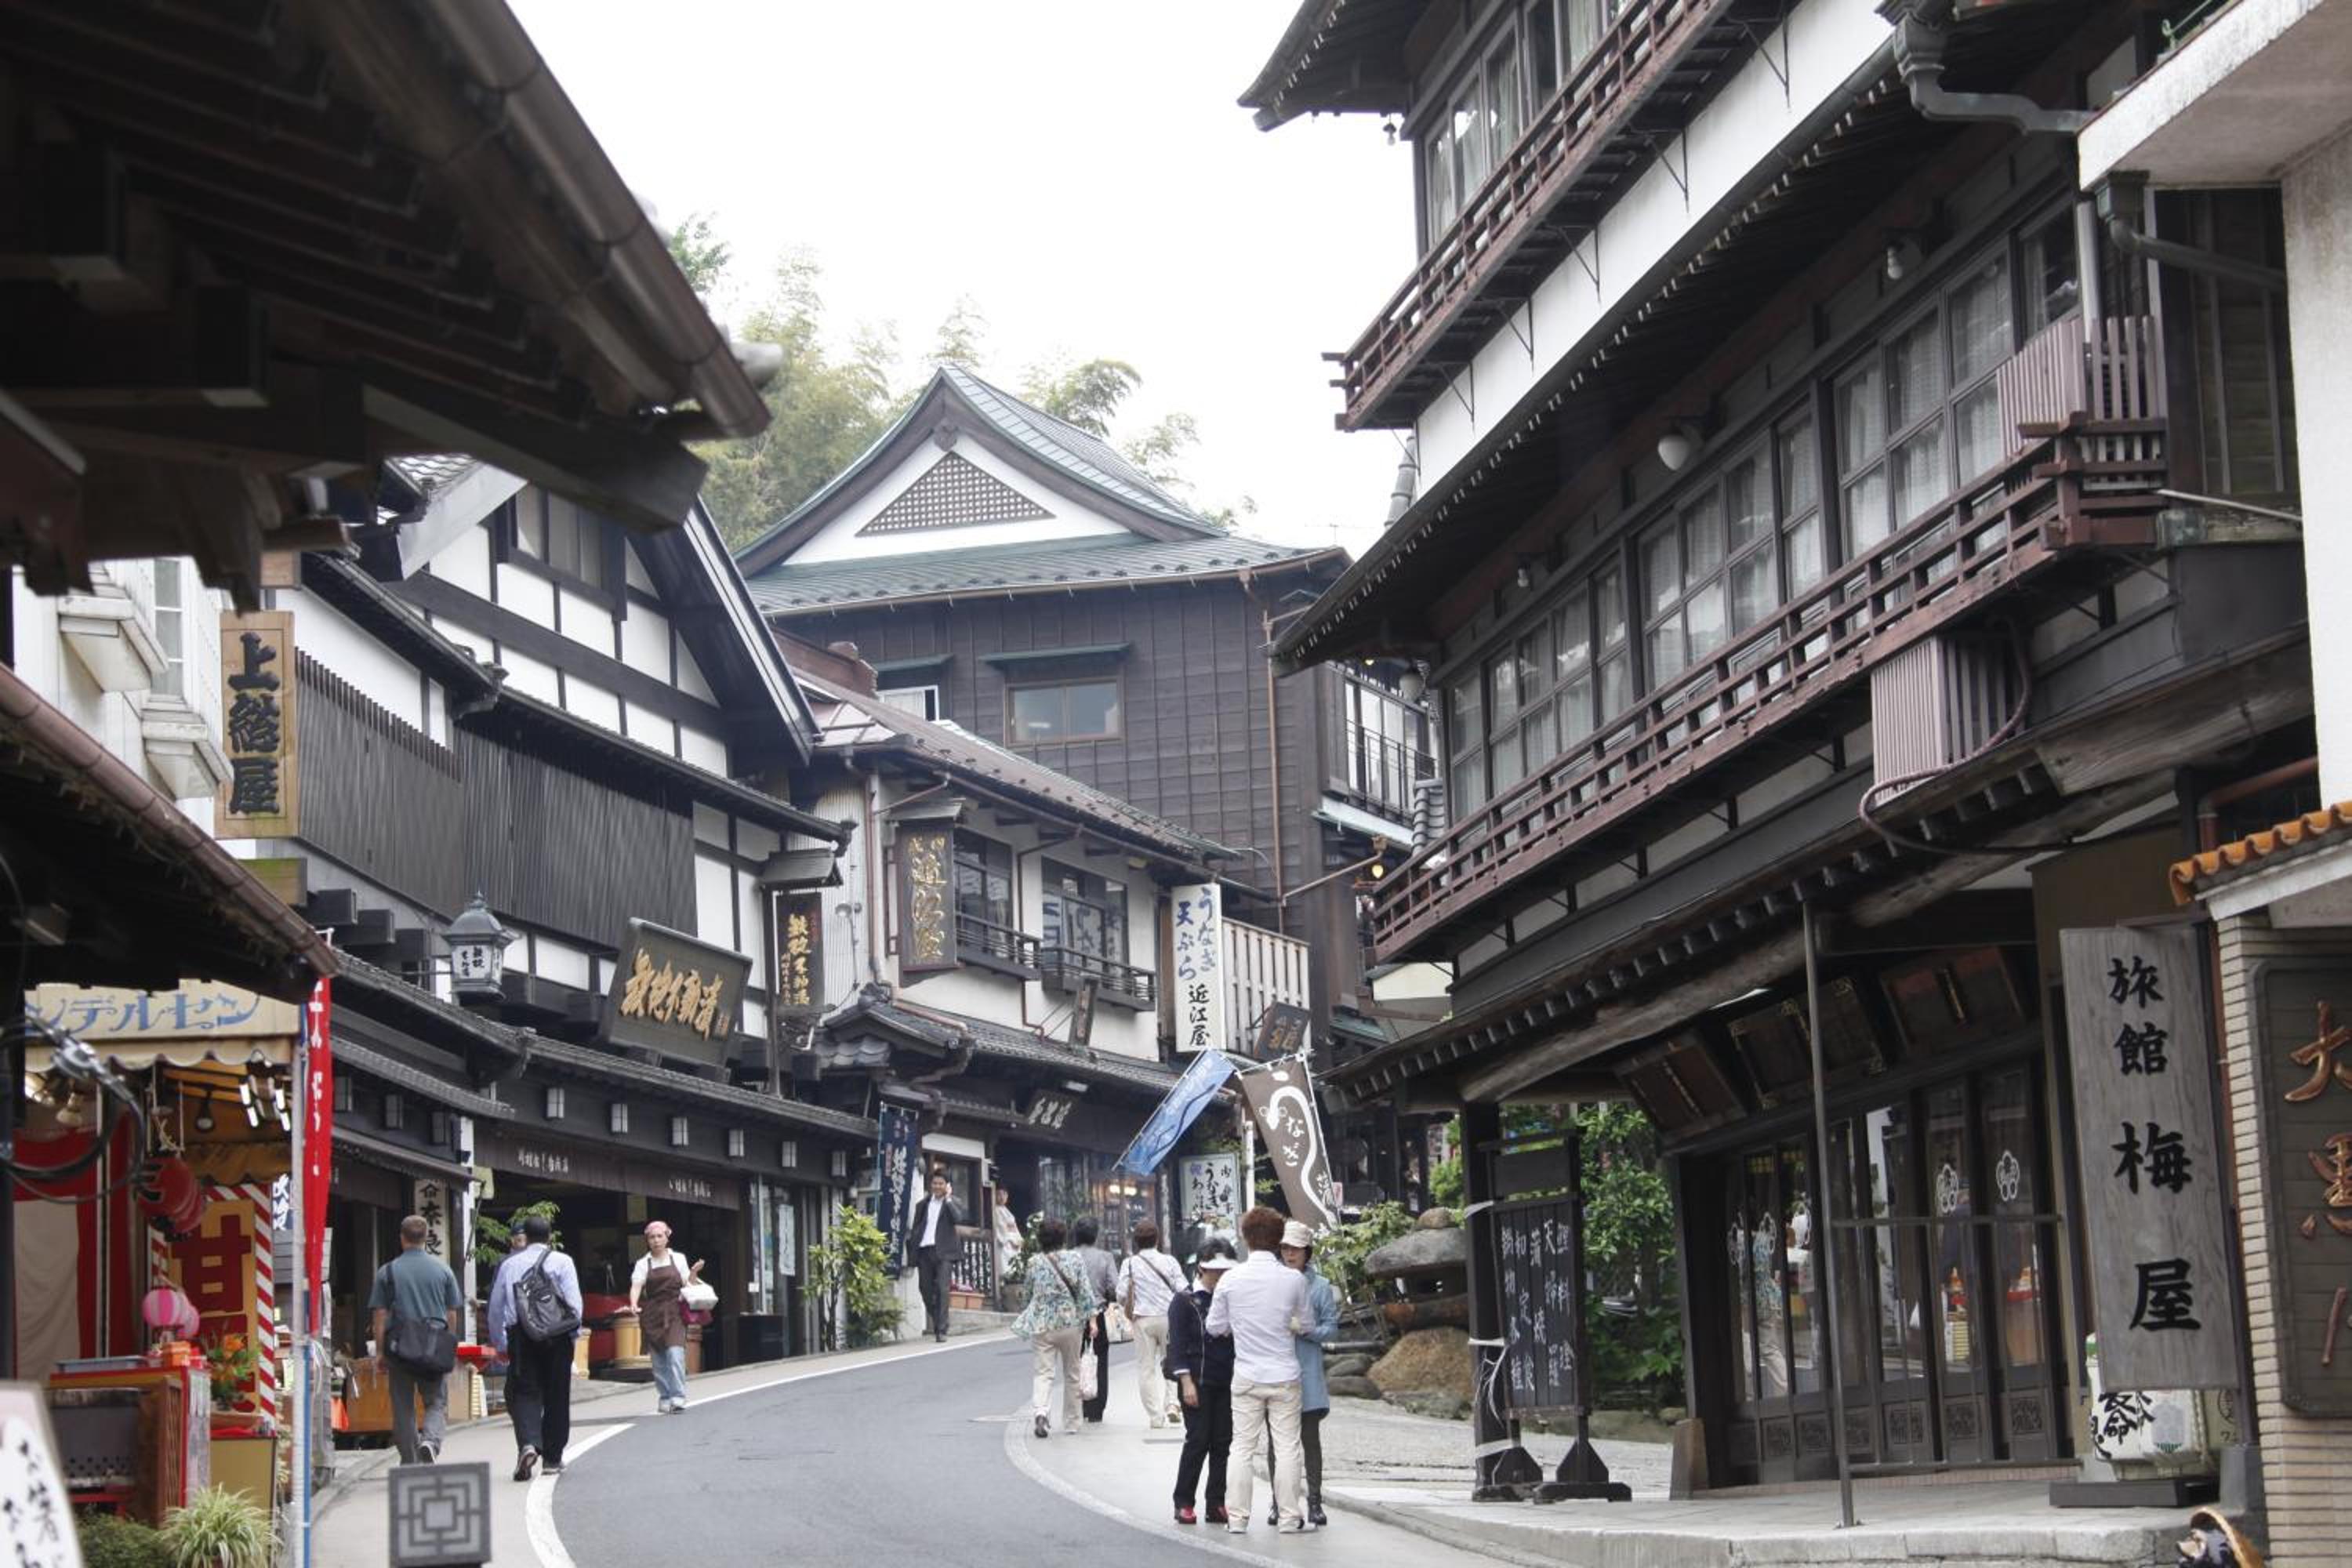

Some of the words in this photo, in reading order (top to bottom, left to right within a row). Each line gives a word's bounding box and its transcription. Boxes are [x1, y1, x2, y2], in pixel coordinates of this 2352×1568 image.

[1198, 887, 1216, 973] うなぎ
[1189, 983, 1210, 1047] 近江屋
[2107, 956, 2201, 1332] 旅館梅屋
